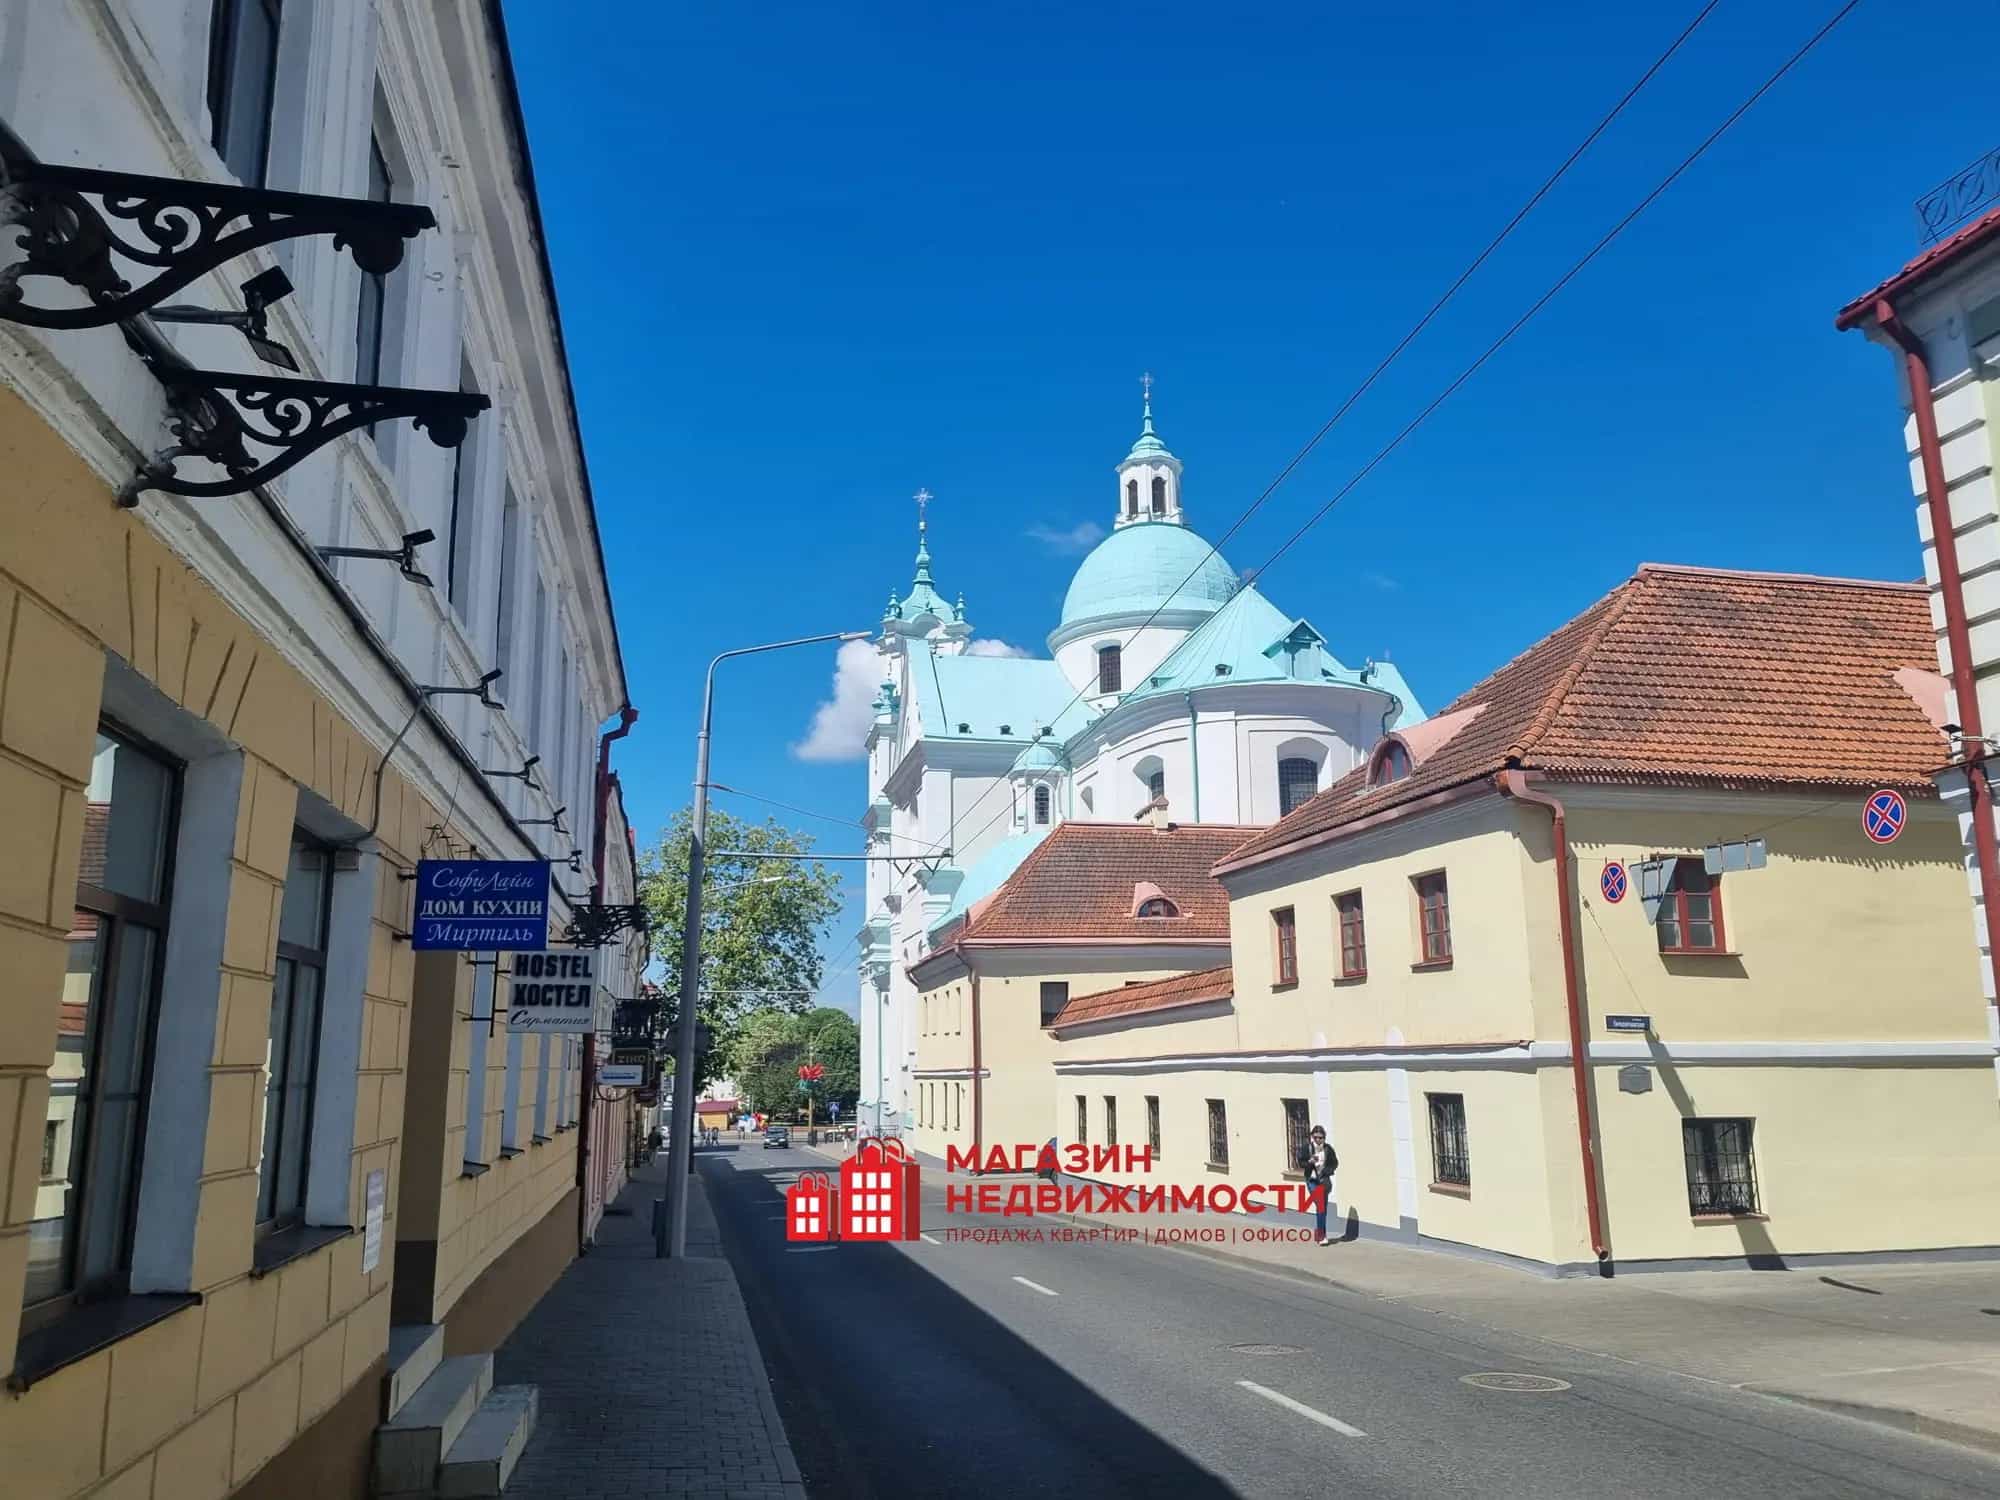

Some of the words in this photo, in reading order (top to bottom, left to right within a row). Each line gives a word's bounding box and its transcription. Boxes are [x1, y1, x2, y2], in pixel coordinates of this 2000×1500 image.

[420, 900, 464, 916] ДОМ
[472, 900, 543, 915] КУХНИ
[426, 923, 534, 948] Миртиль
[515, 954, 593, 978] HOSTEL
[512, 984, 591, 1008] ХОСТЕЛ
